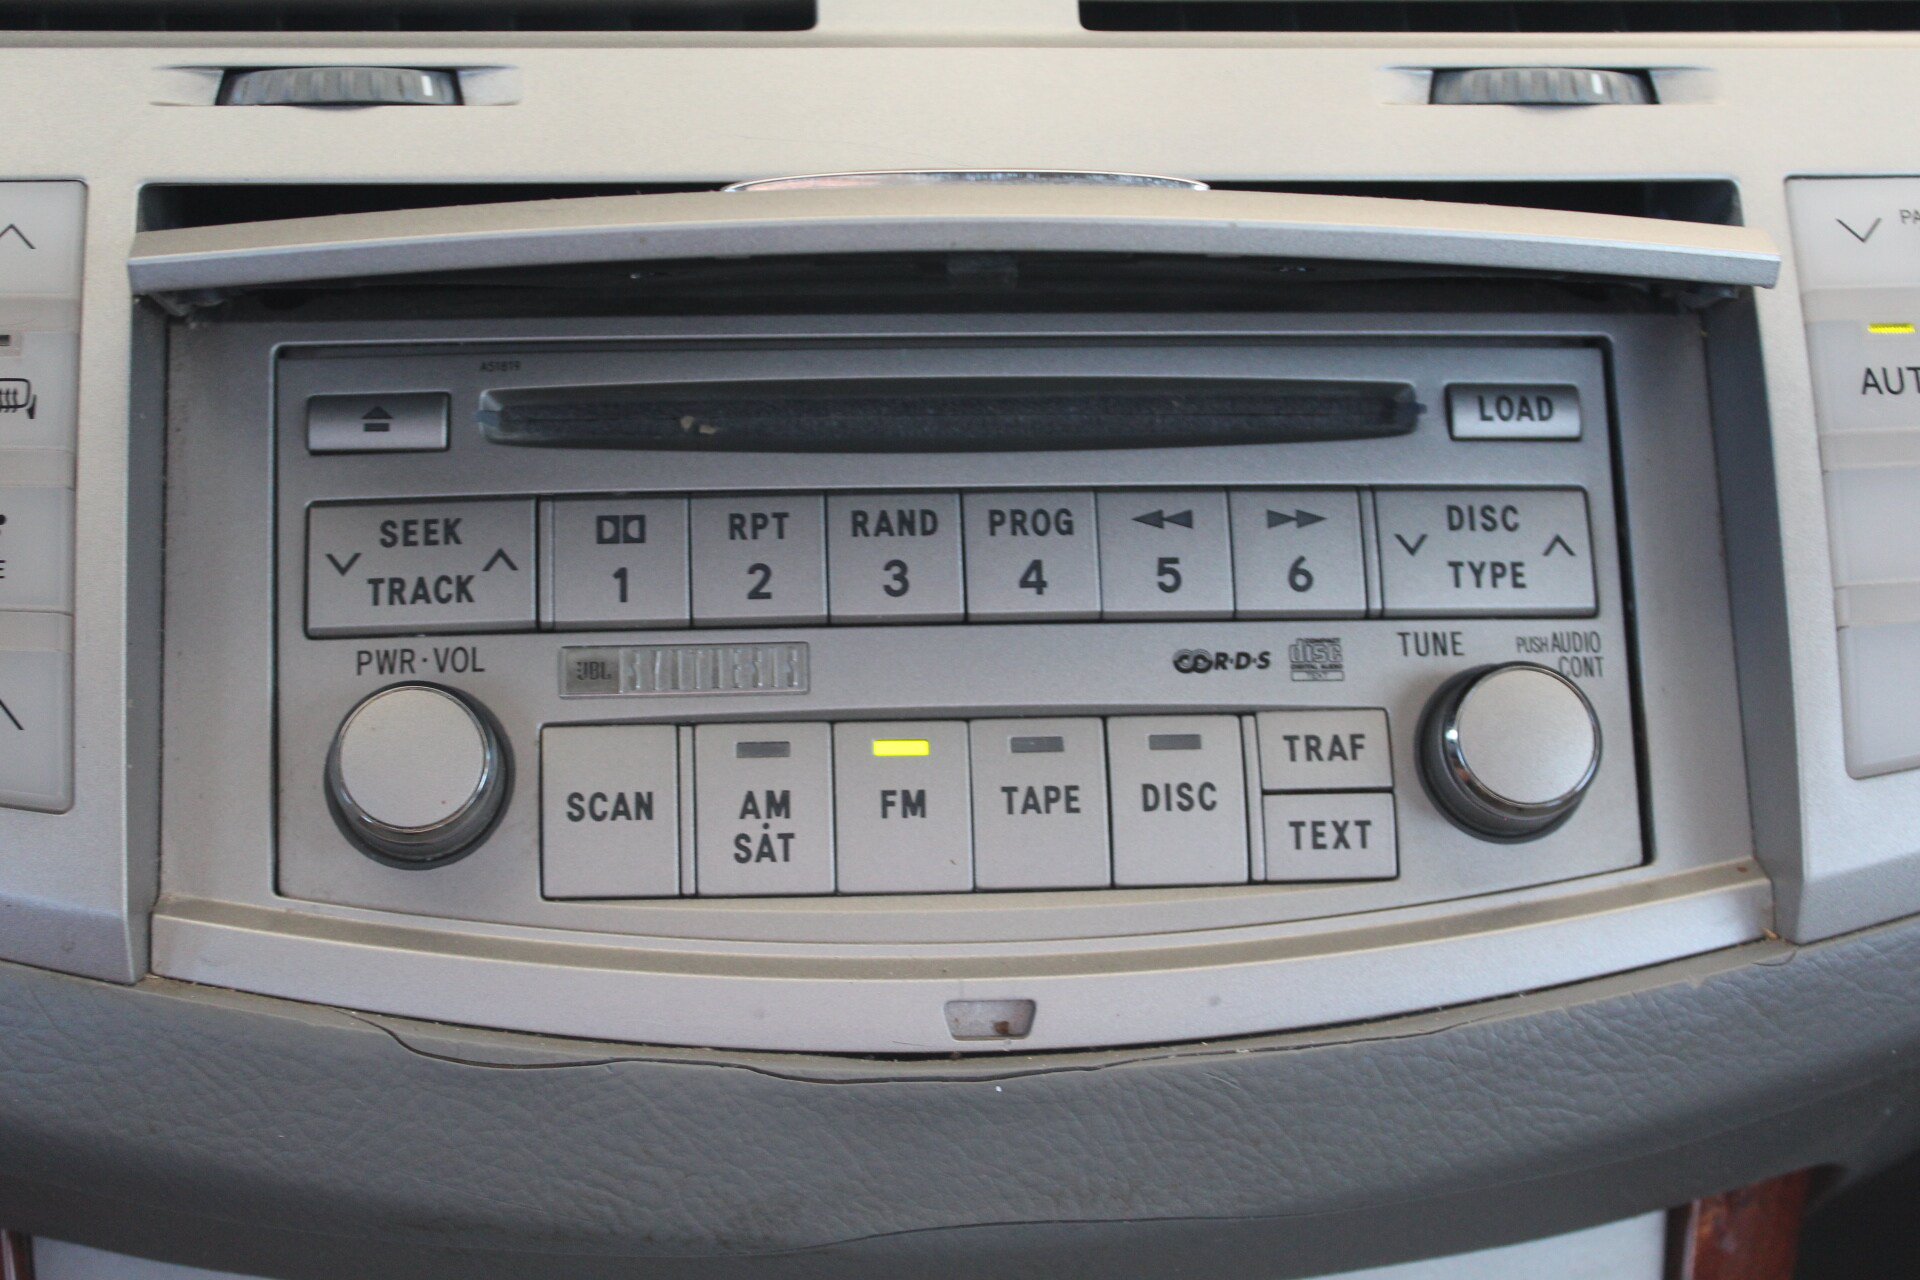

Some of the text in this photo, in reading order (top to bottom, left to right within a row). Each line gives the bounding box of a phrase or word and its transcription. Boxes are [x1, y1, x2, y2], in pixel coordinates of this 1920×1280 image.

[1477, 393, 1556, 424] LOAD
[379, 517, 463, 549] SEEK
[728, 511, 790, 541] RPT
[850, 508, 939, 538] RAND
[988, 507, 1074, 537] PROG
[1445, 504, 1520, 533] DISC
[612, 566, 628, 603] 1
[747, 562, 772, 600] 2
[883, 558, 910, 598] 3
[1018, 559, 1048, 596] 4
[1156, 556, 1182, 594] 5
[1287, 555, 1314, 593] 6
[1447, 560, 1527, 589] TYPE
[366, 574, 475, 607] TRACK
[1396, 631, 1465, 658] TUNE
[1516, 630, 1602, 655] PUSH AUDIO
[1557, 655, 1605, 678] CONT
[1282, 733, 1366, 762] TRAF
[566, 791, 654, 823] SCAN
[739, 789, 791, 820] AM
[880, 789, 927, 819] FM
[1000, 784, 1081, 815] TAPE
[1141, 781, 1217, 813] DISC
[733, 832, 795, 864] SAT
[1288, 819, 1372, 851] TEXT
